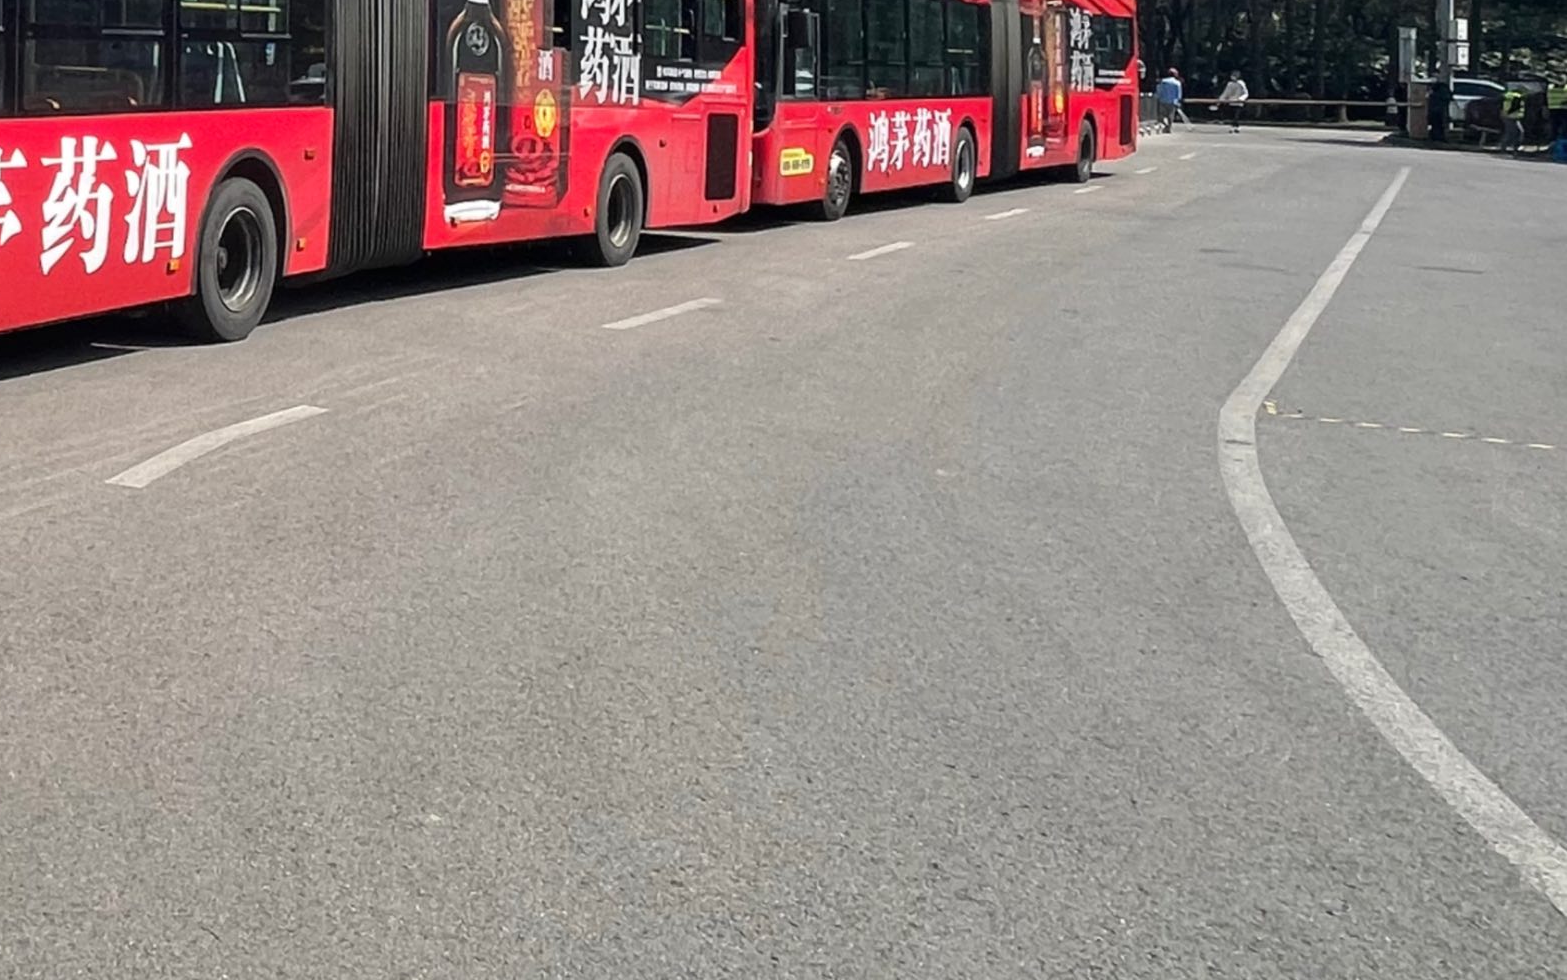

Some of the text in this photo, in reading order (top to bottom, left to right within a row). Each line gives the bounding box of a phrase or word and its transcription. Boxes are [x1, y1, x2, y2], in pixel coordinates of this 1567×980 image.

[580, 26, 641, 106] 药酒
[867, 107, 952, 173] 鸿茅药酒
